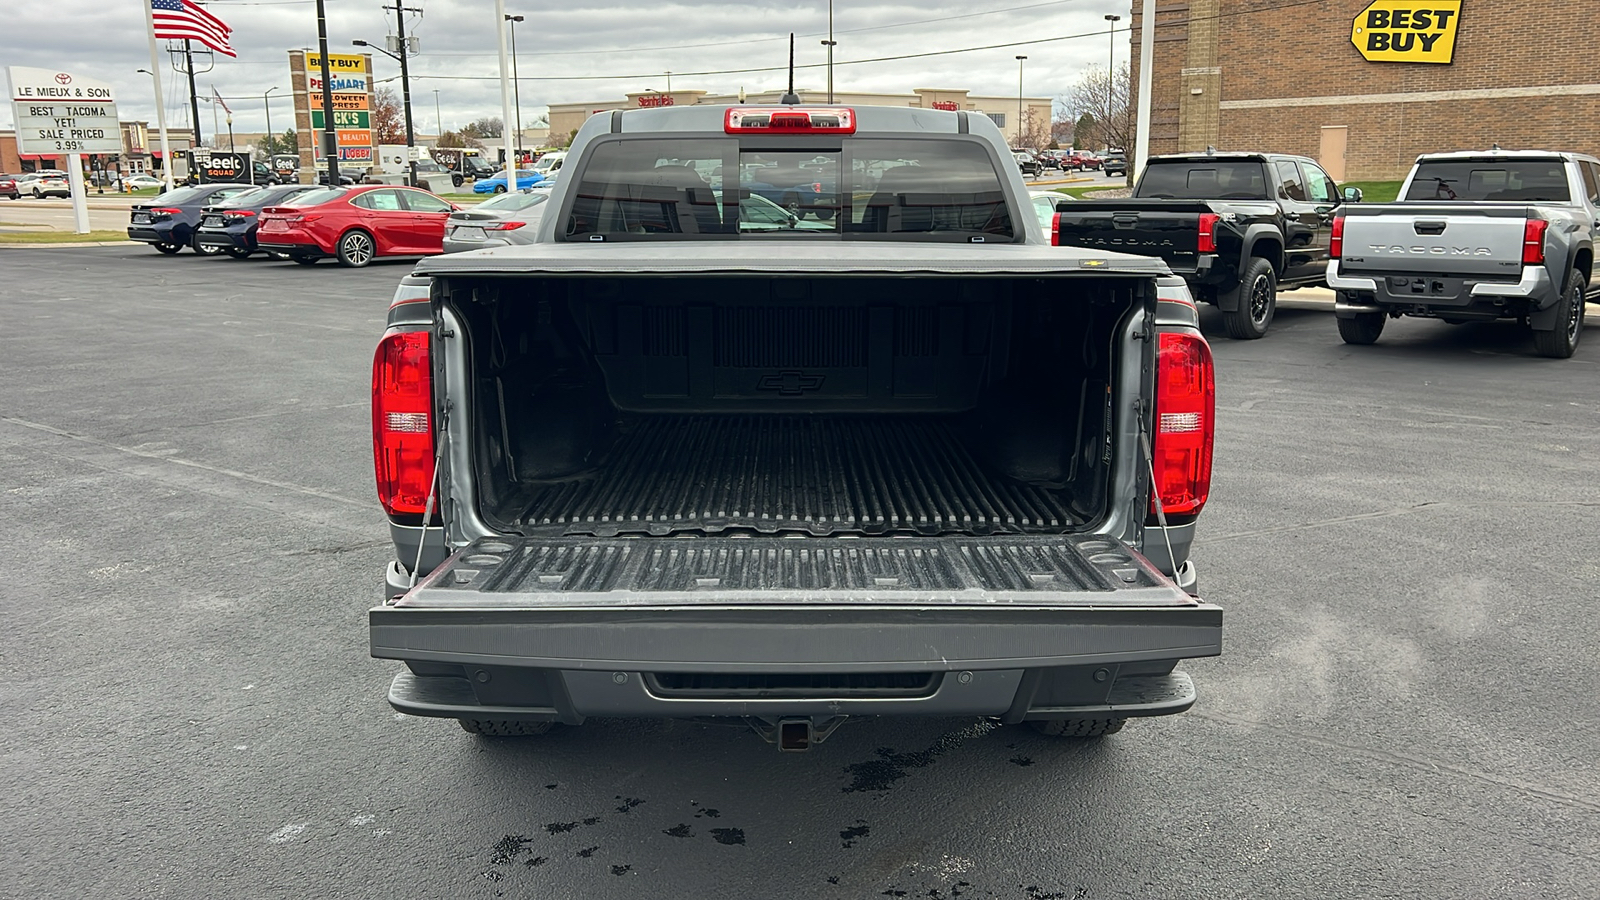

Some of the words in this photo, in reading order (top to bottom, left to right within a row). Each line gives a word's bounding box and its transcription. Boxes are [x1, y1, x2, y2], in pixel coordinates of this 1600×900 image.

[1366, 10, 1454, 30] BEST
[1367, 32, 1443, 52] BUY
[310, 78, 365, 90] PESMART
[18, 87, 33, 96] LE
[37, 87, 70, 97] MIEUX
[75, 88, 82, 97] &
[87, 88, 110, 97] SON
[30, 107, 54, 116] BEST
[66, 107, 106, 116] TACOMA
[54, 118, 76, 127] YET!
[323, 112, 359, 124] CK'S
[39, 130, 64, 139] SALE
[71, 130, 104, 139] PRICED
[56, 141, 84, 150] 3.99%
[346, 148, 371, 159] LOBBY
[276, 159, 294, 169] Geek
[1079, 237, 1174, 246] TACOMA
[1369, 244, 1492, 256] TACOMA
